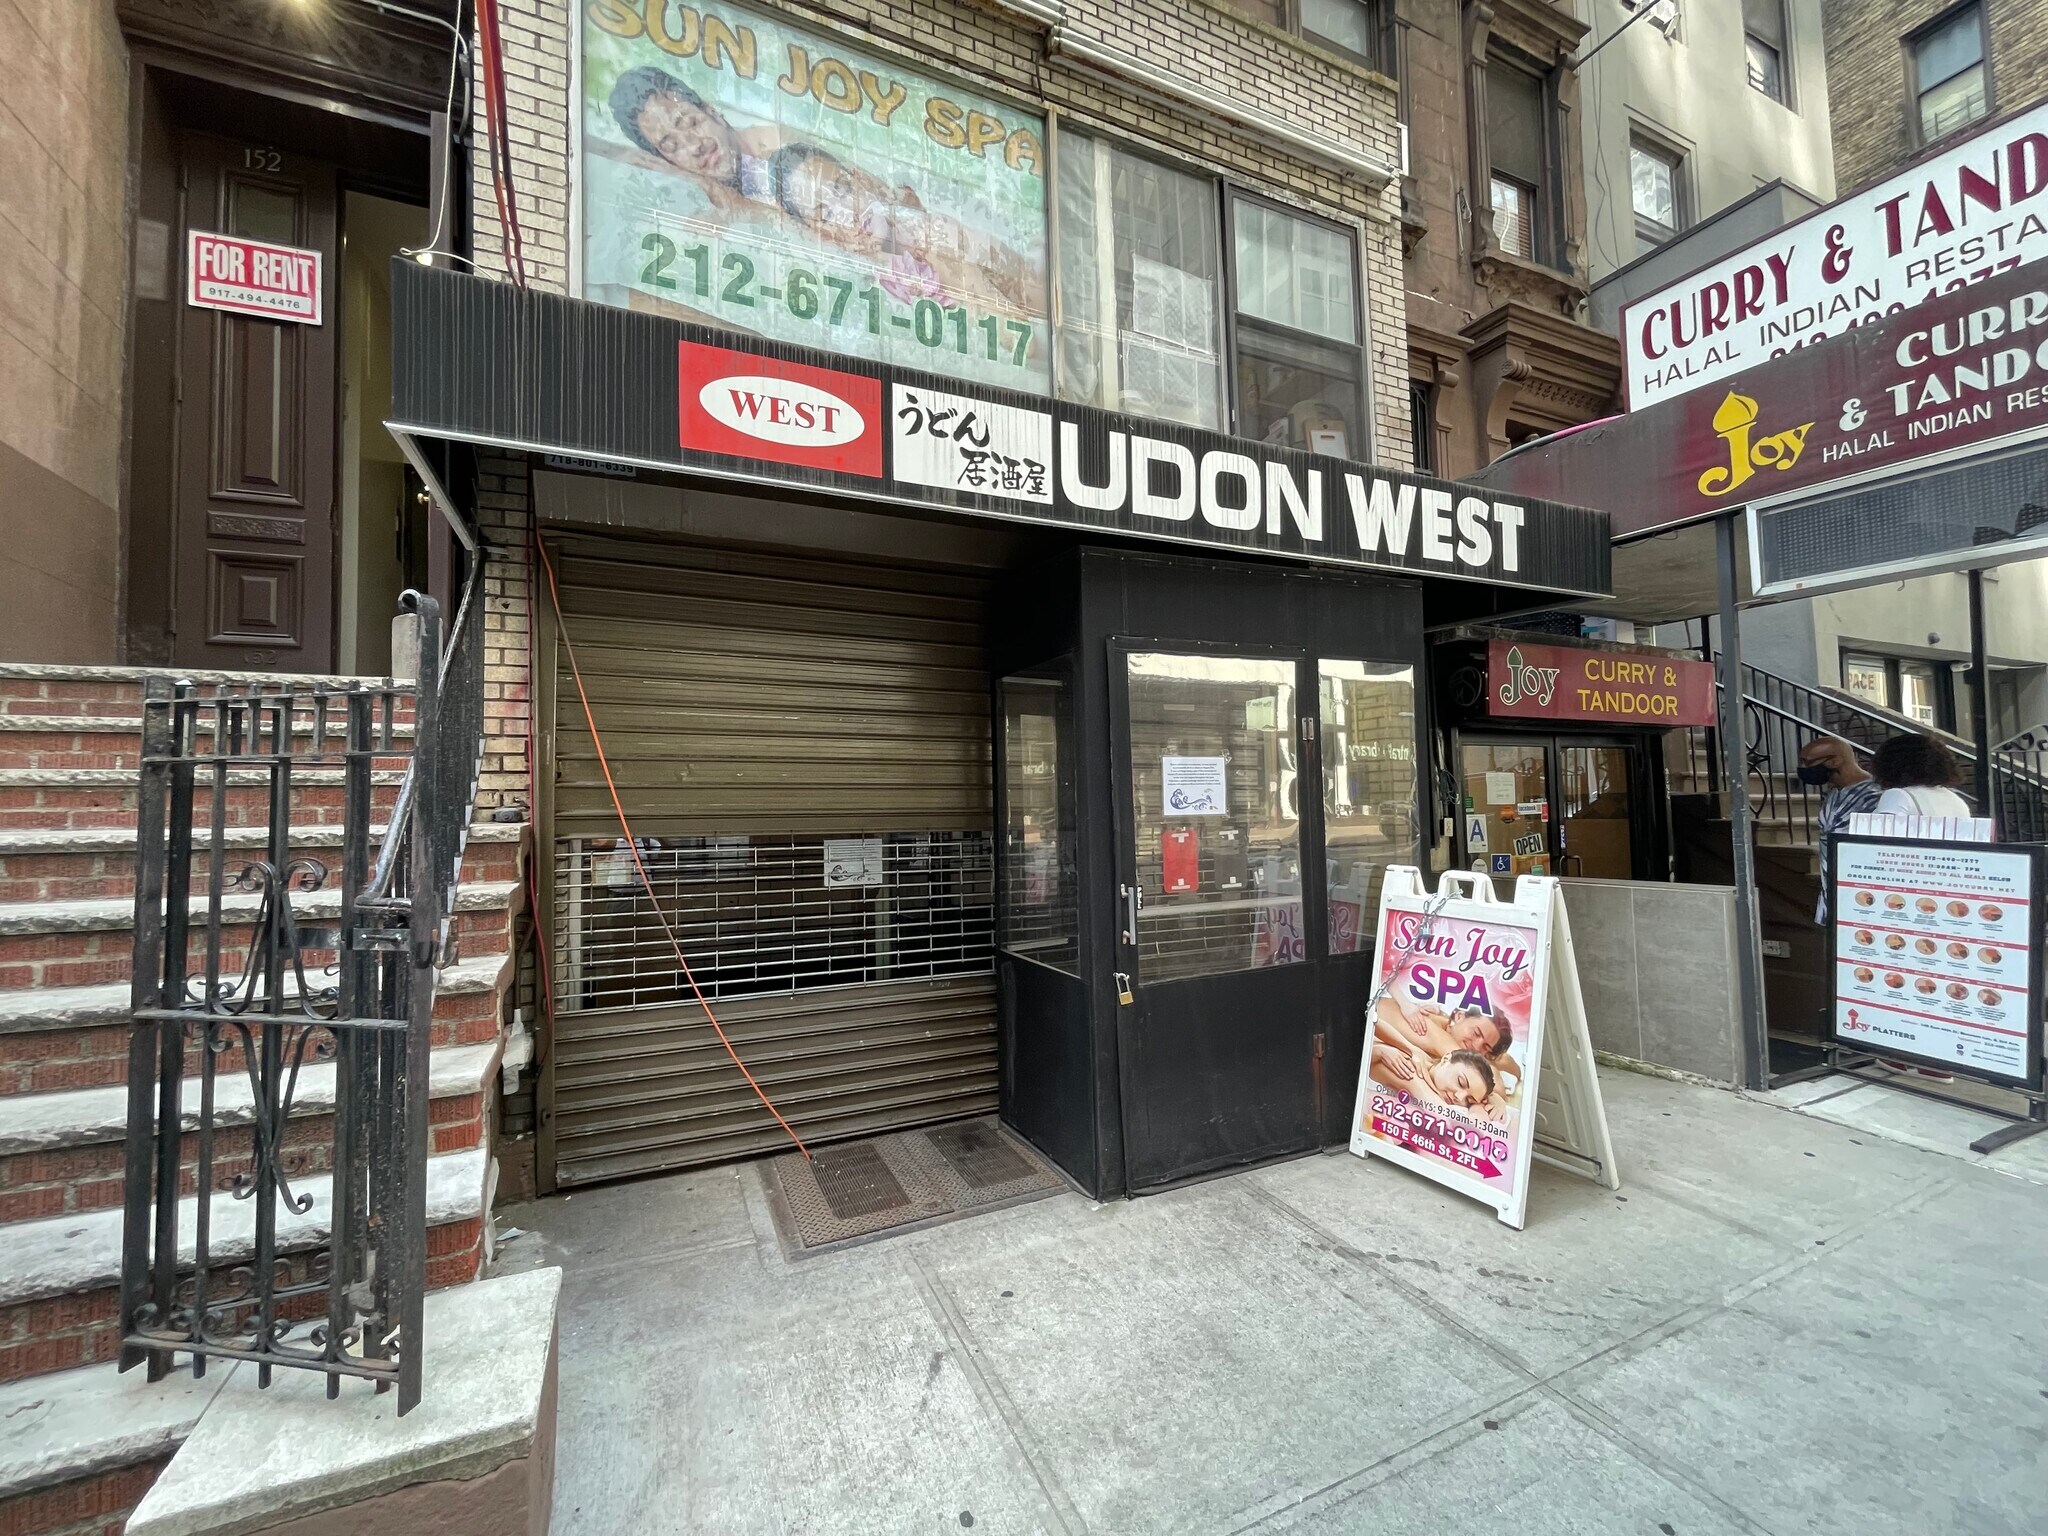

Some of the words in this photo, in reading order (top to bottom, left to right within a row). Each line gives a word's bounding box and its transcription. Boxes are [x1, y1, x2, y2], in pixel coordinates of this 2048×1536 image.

[586, 0, 758, 80] SUN
[778, 43, 907, 128] JOY
[923, 97, 1044, 176] SPA
[244, 148, 281, 172] 152
[200, 240, 246, 283] FOR
[253, 250, 312, 294] RENT
[1641, 245, 1796, 360] CURRY
[1821, 224, 1853, 284] &
[1874, 131, 2048, 258] TAND
[208, 287, 301, 309] 917-494-4476
[640, 233, 1032, 367] 212-671-0117
[1643, 340, 1741, 393] HALAL
[1760, 278, 1881, 346] INDIAN
[1906, 213, 2047, 288] RESTA
[1896, 291, 2048, 368] CURR
[728, 388, 841, 433] WEST
[899, 392, 990, 448] うどん
[1823, 430, 1895, 463] HALAL
[1908, 401, 1992, 440] INDIAN
[1839, 398, 1868, 431] &
[957, 446, 1048, 497] 居酒屋
[1698, 420, 1815, 497] Joy
[1060, 421, 1323, 542] UDON
[1344, 472, 1525, 572] WEST
[1499, 661, 1560, 707] Joy
[1584, 658, 1656, 685] CURRY
[1664, 666, 1677, 687] &
[1577, 688, 1679, 716] TANDOOR
[1470, 819, 1485, 842] A
[1515, 834, 1541, 856] OPEN
[1878, 852, 1920, 860] TELEPHONE
[1393, 917, 1457, 958] Sun
[1458, 927, 1529, 981] Joy
[1409, 963, 1493, 1016] SPA
[1872, 1025, 1916, 1041] PLATTERS
[1376, 1084, 1397, 1098] OPEN
[1401, 1091, 1409, 1102] 7
[1412, 1097, 1436, 1113] DAYS:
[1437, 1103, 1509, 1139] 9:30am-1:30am
[1381, 1121, 1400, 1137] 150
[1402, 1128, 1410, 1141] E
[1411, 1133, 1436, 1152] 46th
[1438, 1144, 1453, 1161] St,
[1456, 1151, 1479, 1169] 2FL
